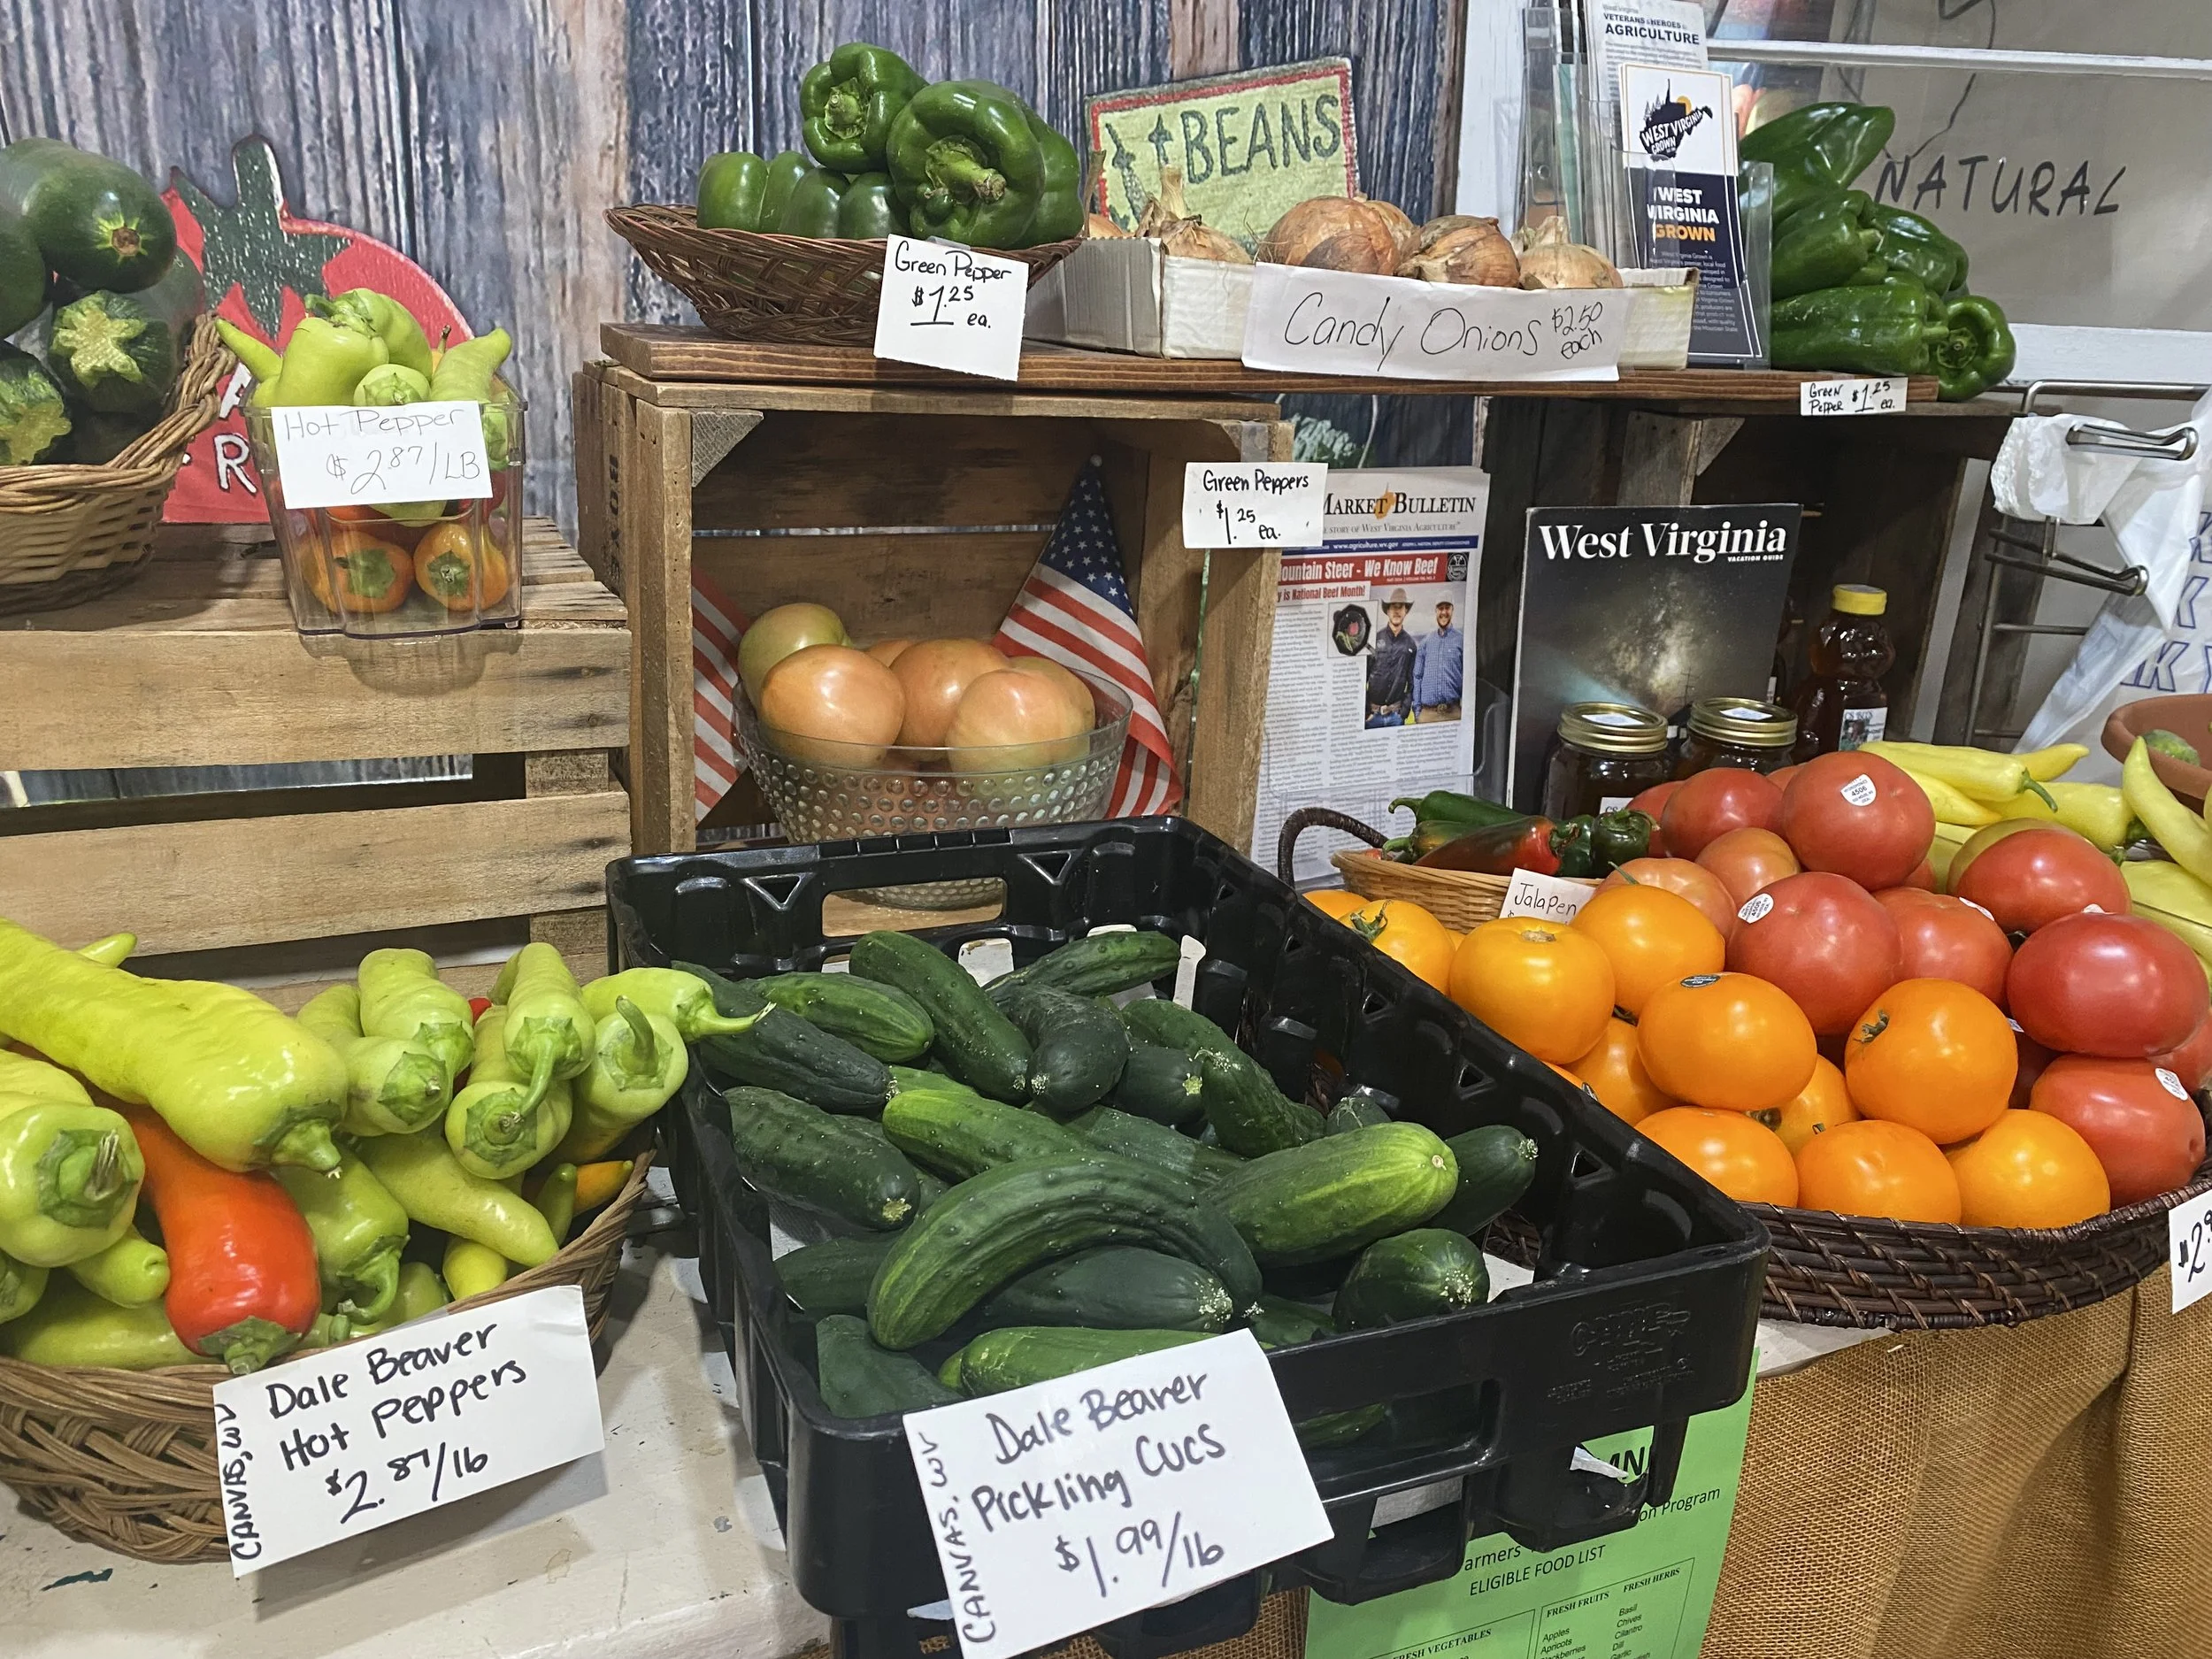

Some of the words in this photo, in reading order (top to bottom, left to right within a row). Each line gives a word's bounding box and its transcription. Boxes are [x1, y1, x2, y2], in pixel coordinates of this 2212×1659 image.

[1603, 13, 1646, 25] VETERANS
[1650, 19, 1681, 29] HEROES
[1605, 23, 1700, 45] AGRICULTURE
[1180, 94, 1341, 184] BEANS
[1641, 122, 1670, 147] WEST
[1670, 110, 1702, 137] VIRGINIA
[1651, 136, 1677, 155] GROWN
[1657, 186, 1703, 204] WEST
[1874, 154, 2127, 217] NATURAL
[1647, 204, 1720, 225] VIRGINIA
[1655, 223, 1717, 242] GROWN
[895, 240, 947, 277] Green
[945, 250, 1012, 284] Pepper
[1284, 292, 1405, 372] Candy
[1420, 307, 1542, 356] Onions
[1551, 302, 1603, 336] $2.50
[1561, 328, 1603, 359] each
[283, 410, 341, 442] Hot
[339, 408, 465, 437] Pepper
[1202, 469, 1249, 492] Green
[1254, 468, 1310, 495] Peppers
[1392, 491, 1477, 514] BULLETIN
[1216, 500, 1256, 545] $1.25
[1538, 525, 1634, 560] West
[1640, 519, 1787, 564] Virginia
[1325, 560, 1355, 580] Steer
[1363, 559, 1381, 578] We
[1382, 558, 1413, 577] Know
[1414, 557, 1439, 575] Beef
[1283, 588, 1291, 601] is
[1292, 587, 1322, 601] National
[1323, 586, 1340, 599] Beef
[1340, 585, 1366, 598] Month!
[1514, 882, 1577, 917] Jalapen
[265, 1372, 349, 1419] Dale
[366, 1324, 498, 1386] Beaver
[279, 1422, 350, 1471] Hot
[371, 1359, 526, 1439] Peppers
[985, 1408, 1074, 1465] Dale
[1079, 1372, 1209, 1432] Beaver
[971, 1469, 1133, 1533] Pickling
[1135, 1423, 1227, 1477] Cucs
[1661, 1488, 1721, 1517] Program
[1463, 1545, 1522, 1571] armers
[1469, 1565, 1531, 1597] ELIGIBLE
[1533, 1553, 1575, 1578] FOOD
[1578, 1544, 1607, 1565] LIST
[1623, 1578, 1652, 1594] FRESH
[1652, 1567, 1681, 1585] HERBS
[1546, 1601, 1577, 1618] FRESH
[1578, 1590, 1610, 1609] FRUITS
[1618, 1602, 1638, 1617] Basil
[1541, 1626, 1571, 1643] Apples
[1614, 1624, 1644, 1640] Cilantro
[1617, 1614, 1643, 1628] Chives
[1426, 1628, 1493, 1655] VEGETABLES
[1540, 1638, 1573, 1655] Apricots
[1611, 1640, 1625, 1652] Dill
